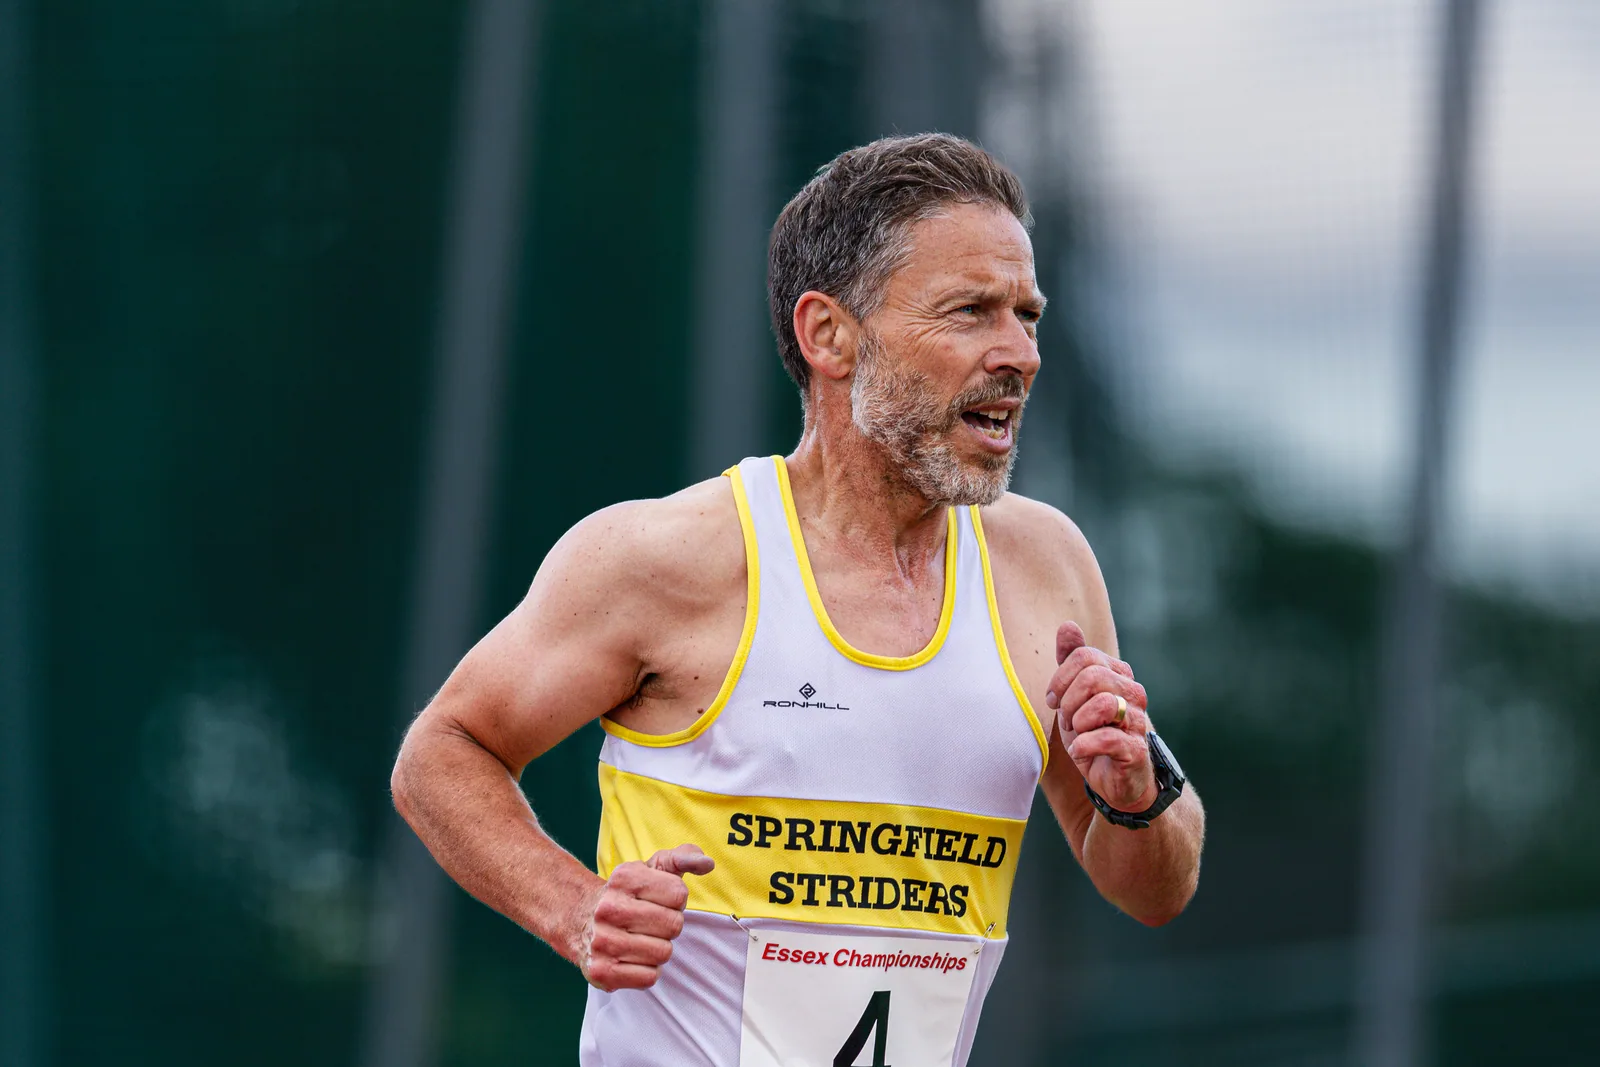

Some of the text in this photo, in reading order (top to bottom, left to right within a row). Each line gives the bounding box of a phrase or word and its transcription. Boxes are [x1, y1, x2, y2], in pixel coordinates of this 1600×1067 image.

[763, 701, 850, 711] RONHILL
[727, 812, 1007, 869] SPRINGFIELD
[768, 871, 970, 918] STRIDERS
[761, 942, 968, 973] Essex Championships
[832, 990, 892, 1067] 4
